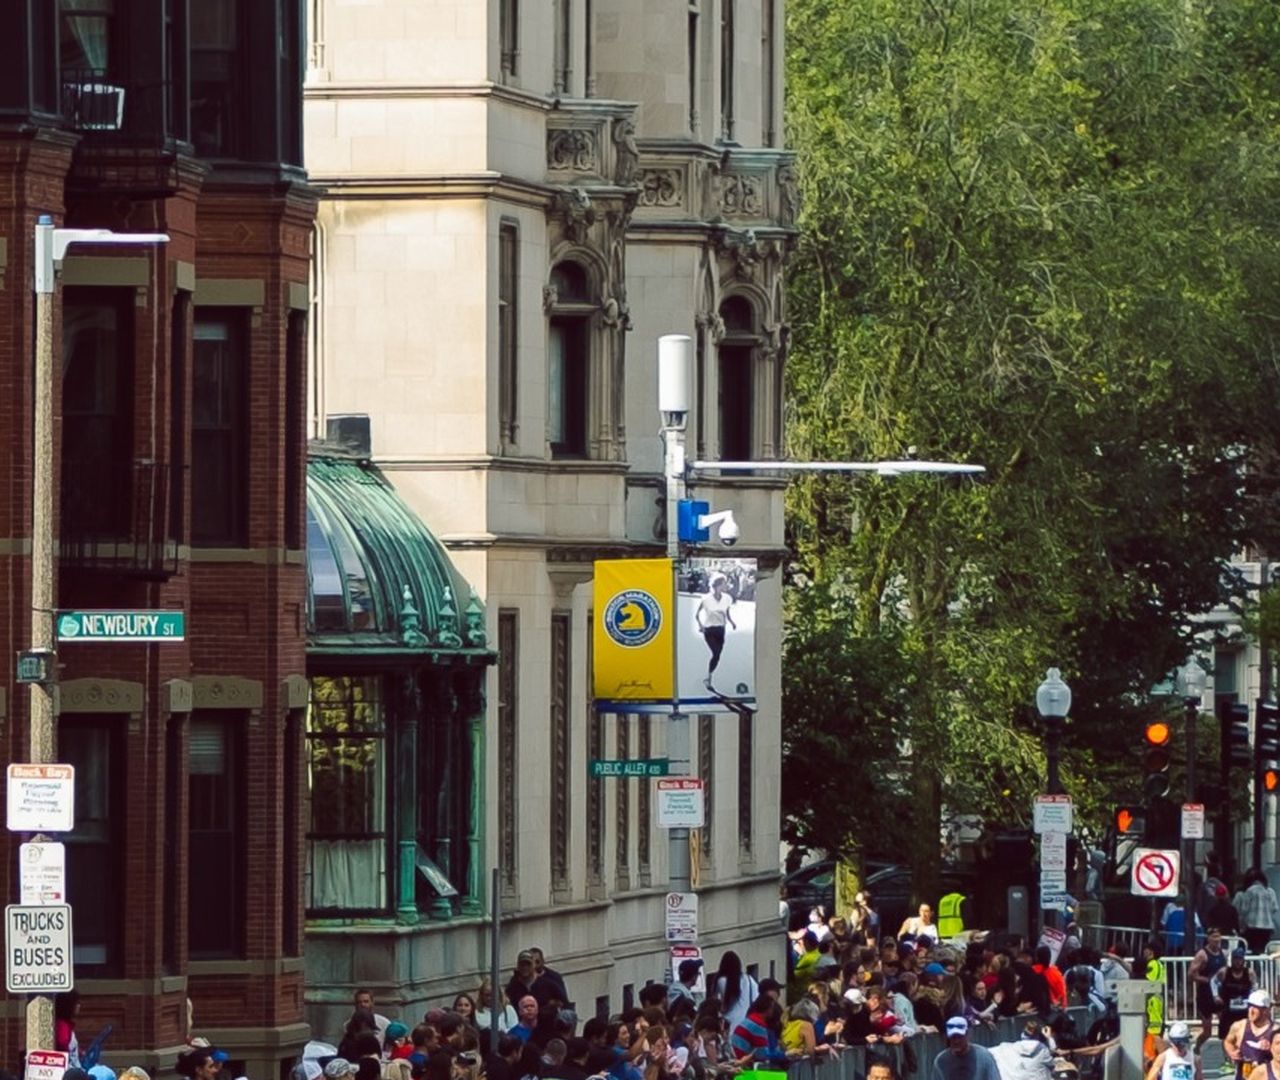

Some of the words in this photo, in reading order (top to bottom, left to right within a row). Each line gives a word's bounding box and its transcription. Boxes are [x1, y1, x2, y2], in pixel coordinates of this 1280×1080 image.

[82, 615, 159, 635] NEWBURY
[163, 622, 175, 635] ST
[595, 762, 621, 775] PUBLIC
[624, 762, 646, 775] ALLEY
[12, 912, 65, 931] TRUCKS
[26, 935, 51, 945] AND
[13, 947, 64, 967] BUSES
[12, 973, 66, 986] EXCLUDED
